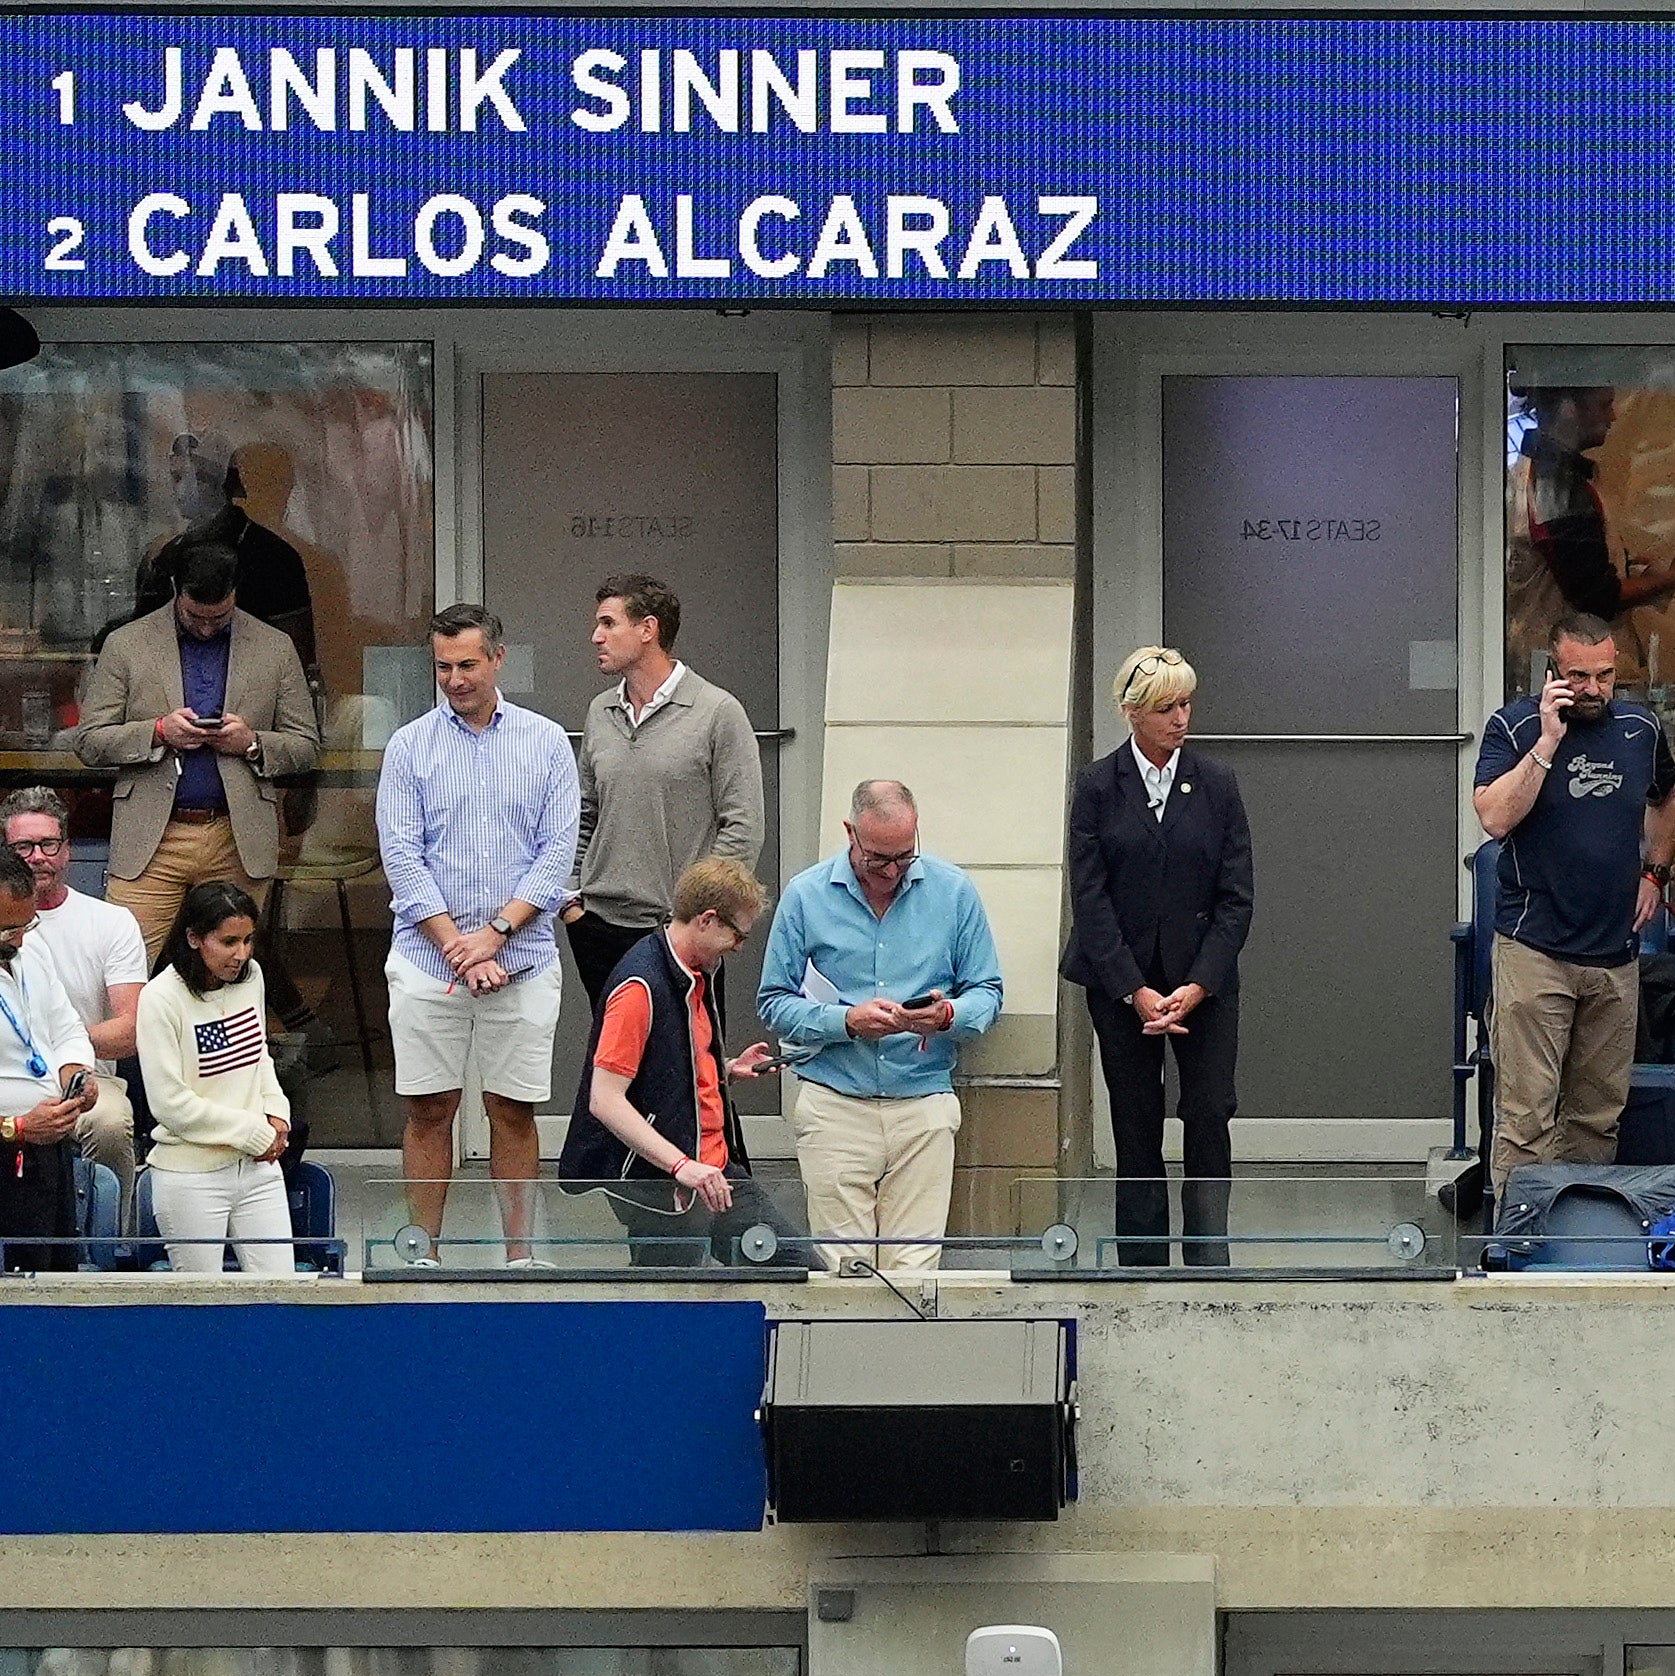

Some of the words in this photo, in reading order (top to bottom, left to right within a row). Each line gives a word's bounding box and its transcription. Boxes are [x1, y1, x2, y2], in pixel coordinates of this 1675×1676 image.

[51, 73, 76, 125] 1
[123, 47, 528, 133] JANNIK
[570, 47, 961, 134] SINNER
[45, 216, 86, 271] 2
[127, 193, 551, 278] CARLOS
[596, 194, 1099, 279] ALCARAZ
